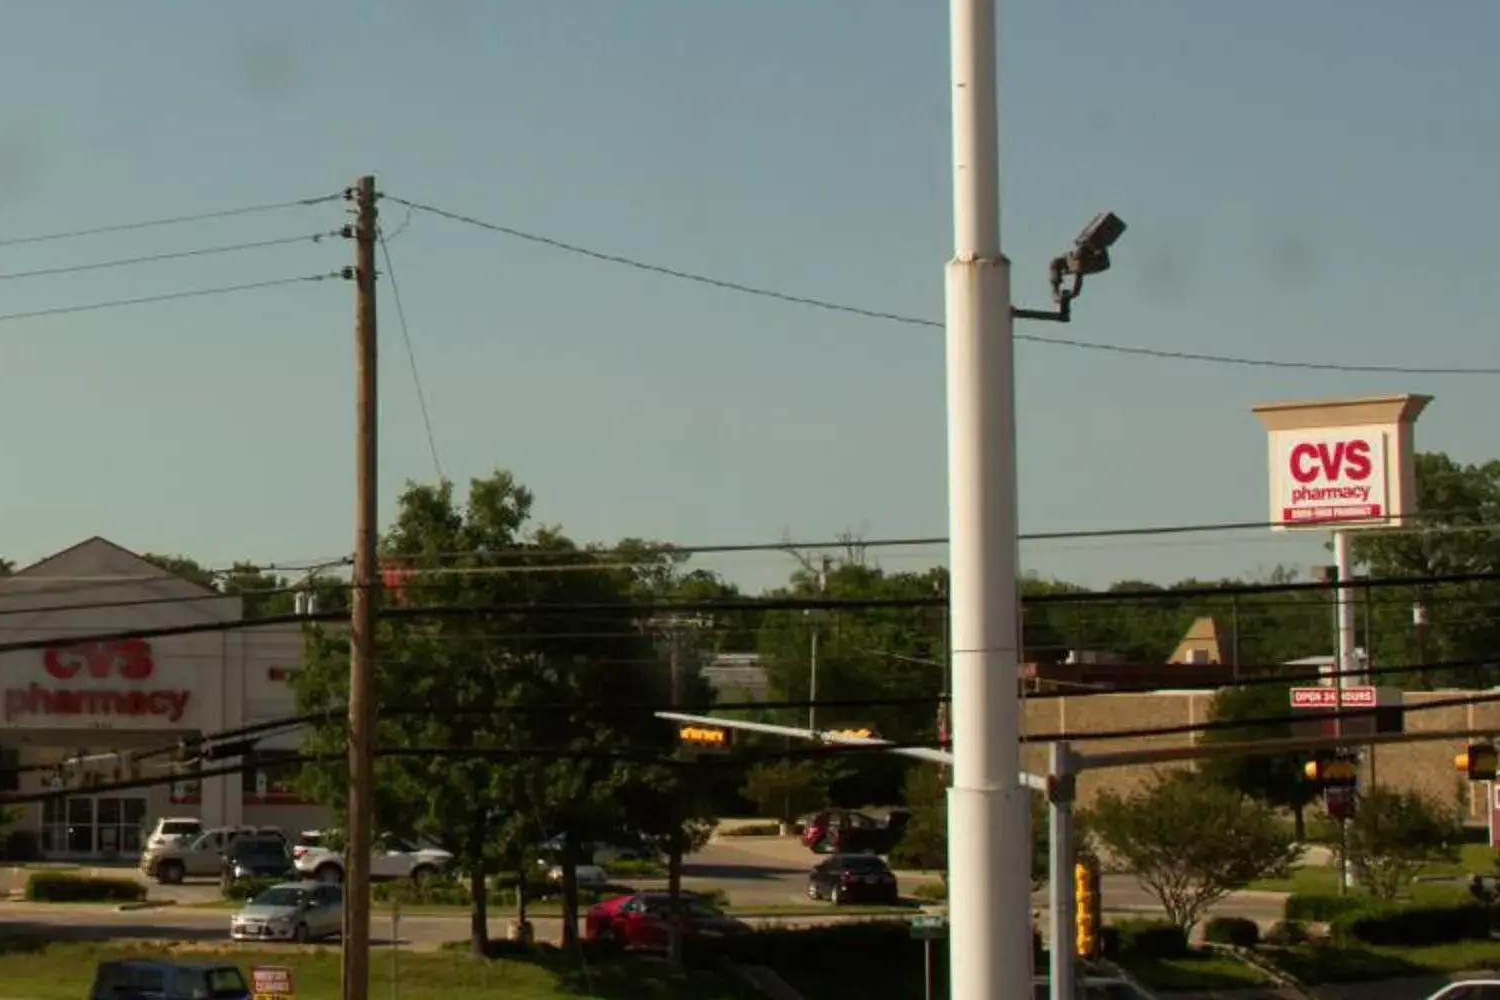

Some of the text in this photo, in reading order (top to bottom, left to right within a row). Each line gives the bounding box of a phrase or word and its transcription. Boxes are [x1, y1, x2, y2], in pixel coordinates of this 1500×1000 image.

[1289, 439, 1372, 483] CVS
[1291, 486, 1371, 504] pharmacy
[43, 635, 154, 680] CVS
[5, 682, 191, 723] pharmacy
